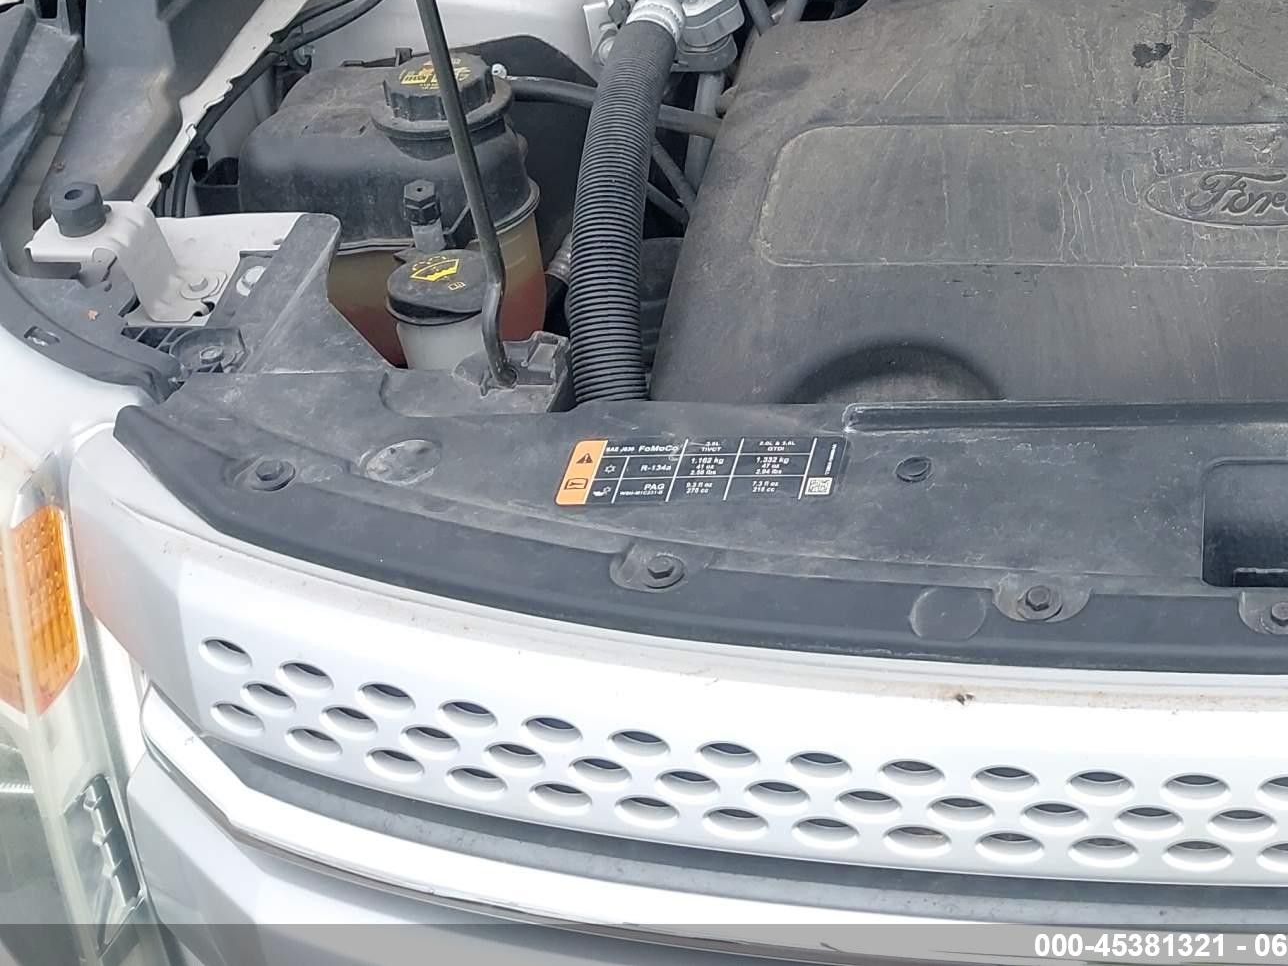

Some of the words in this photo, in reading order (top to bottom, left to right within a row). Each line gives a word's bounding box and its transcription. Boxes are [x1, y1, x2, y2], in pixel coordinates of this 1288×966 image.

[638, 445, 679, 453] FoMoCo
[713, 456, 725, 465] kg
[779, 456, 790, 465] kg
[640, 464, 672, 472] R-134a
